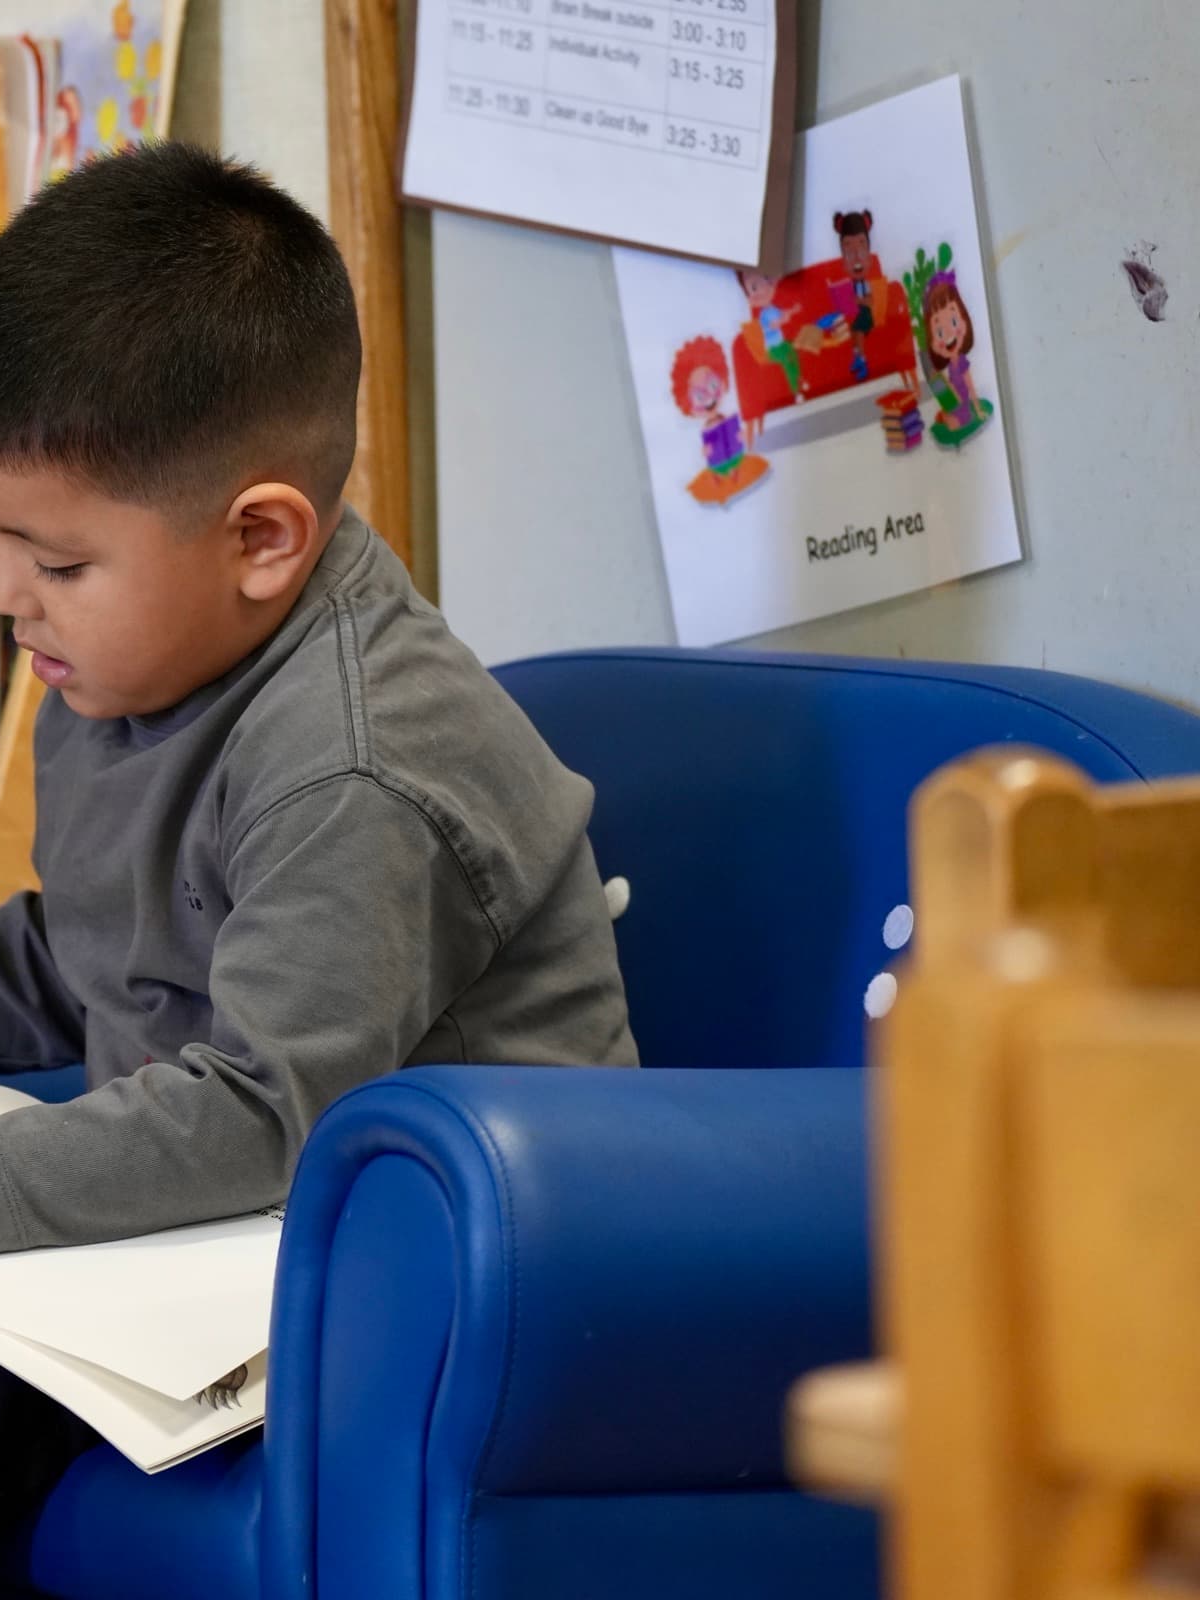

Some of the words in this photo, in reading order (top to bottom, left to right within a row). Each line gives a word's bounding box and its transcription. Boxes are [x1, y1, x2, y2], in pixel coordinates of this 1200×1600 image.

[499, 28, 533, 51] 11:25
[672, 19, 702, 44] 3:00
[716, 27, 746, 51] 3:10
[603, 45, 640, 70] Activity
[670, 57, 701, 82] 3:15
[714, 65, 744, 89] 3:25
[666, 125, 697, 149] 3:25
[710, 132, 741, 157] 3:30
[806, 525, 878, 563] Reading
[883, 512, 925, 542] Area
